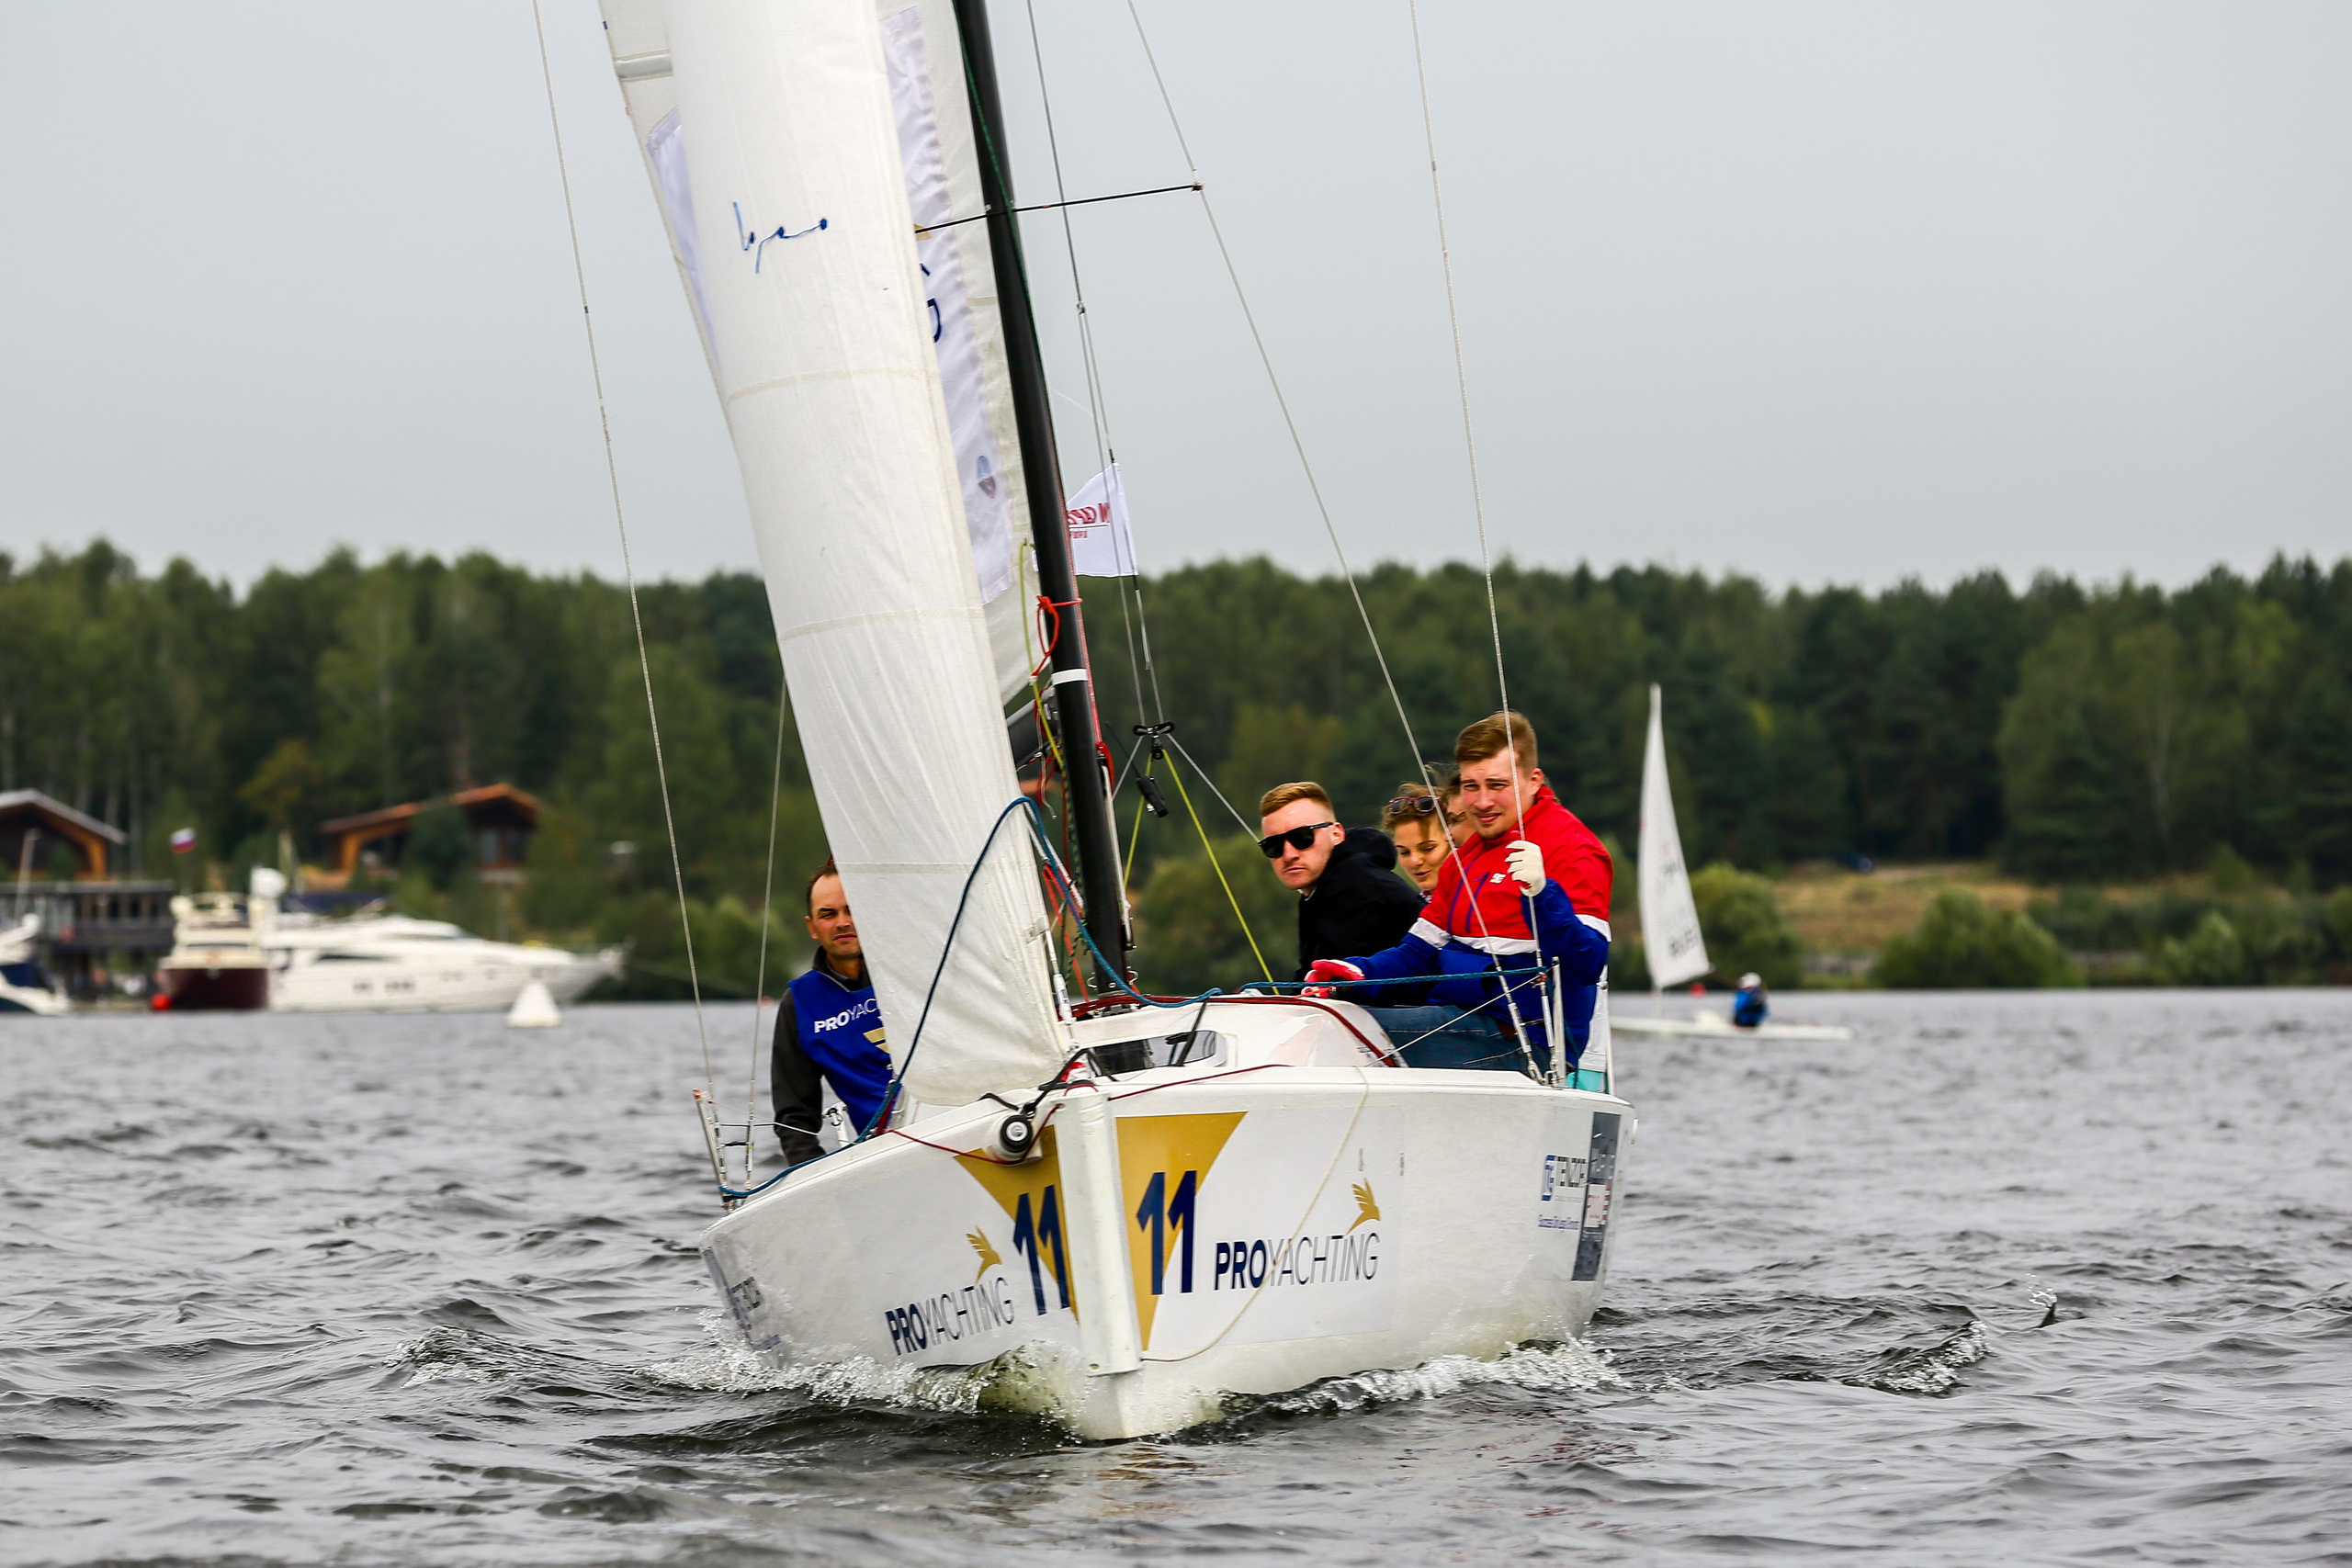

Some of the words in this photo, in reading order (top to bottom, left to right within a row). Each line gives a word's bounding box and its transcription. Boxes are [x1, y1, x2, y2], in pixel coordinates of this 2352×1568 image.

[1012, 1184, 1070, 1316] 11
[1136, 1169, 1198, 1296] 11
[1212, 1232, 1381, 1292] PROYACHTING
[884, 1276, 1015, 1357] PROYACHTING
